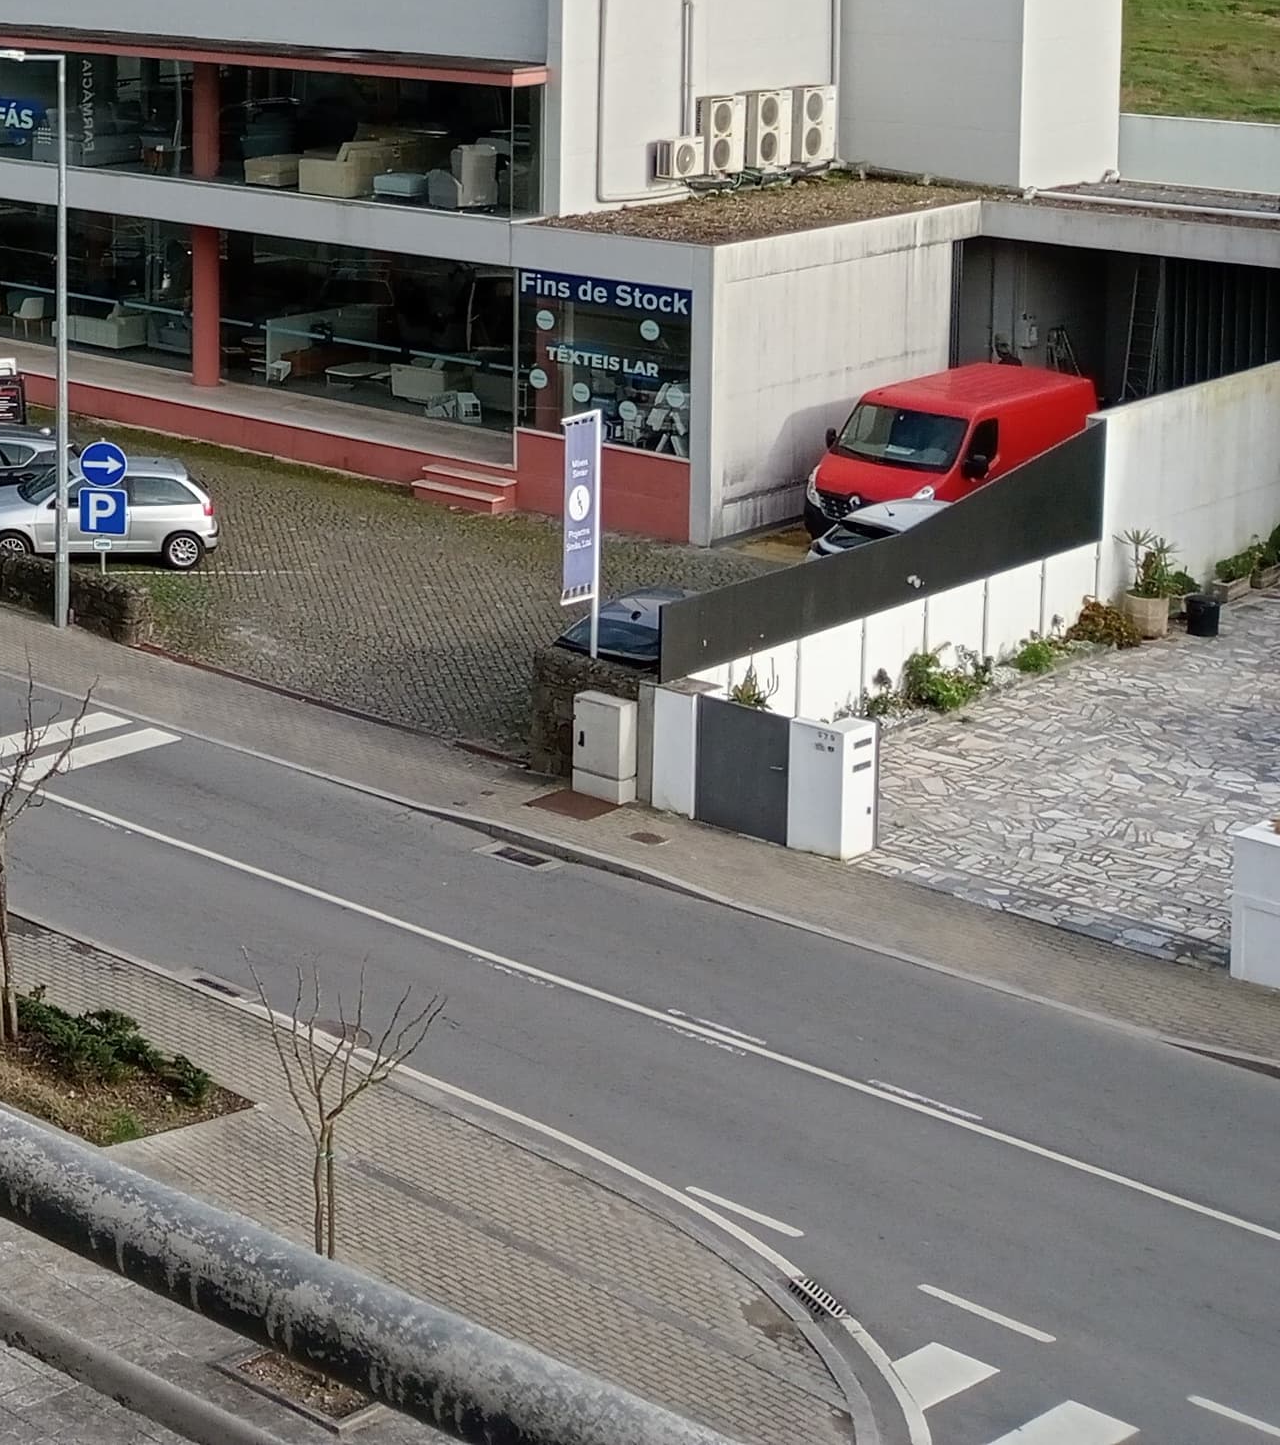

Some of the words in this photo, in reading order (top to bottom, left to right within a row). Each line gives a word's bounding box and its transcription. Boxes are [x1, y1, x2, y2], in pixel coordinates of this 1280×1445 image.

[521, 272, 571, 298] Fins
[578, 281, 608, 304] de
[615, 285, 689, 315] Stock
[546, 345, 620, 372] TÊXTEIS
[623, 358, 659, 378] LAR
[89, 492, 116, 530] P
